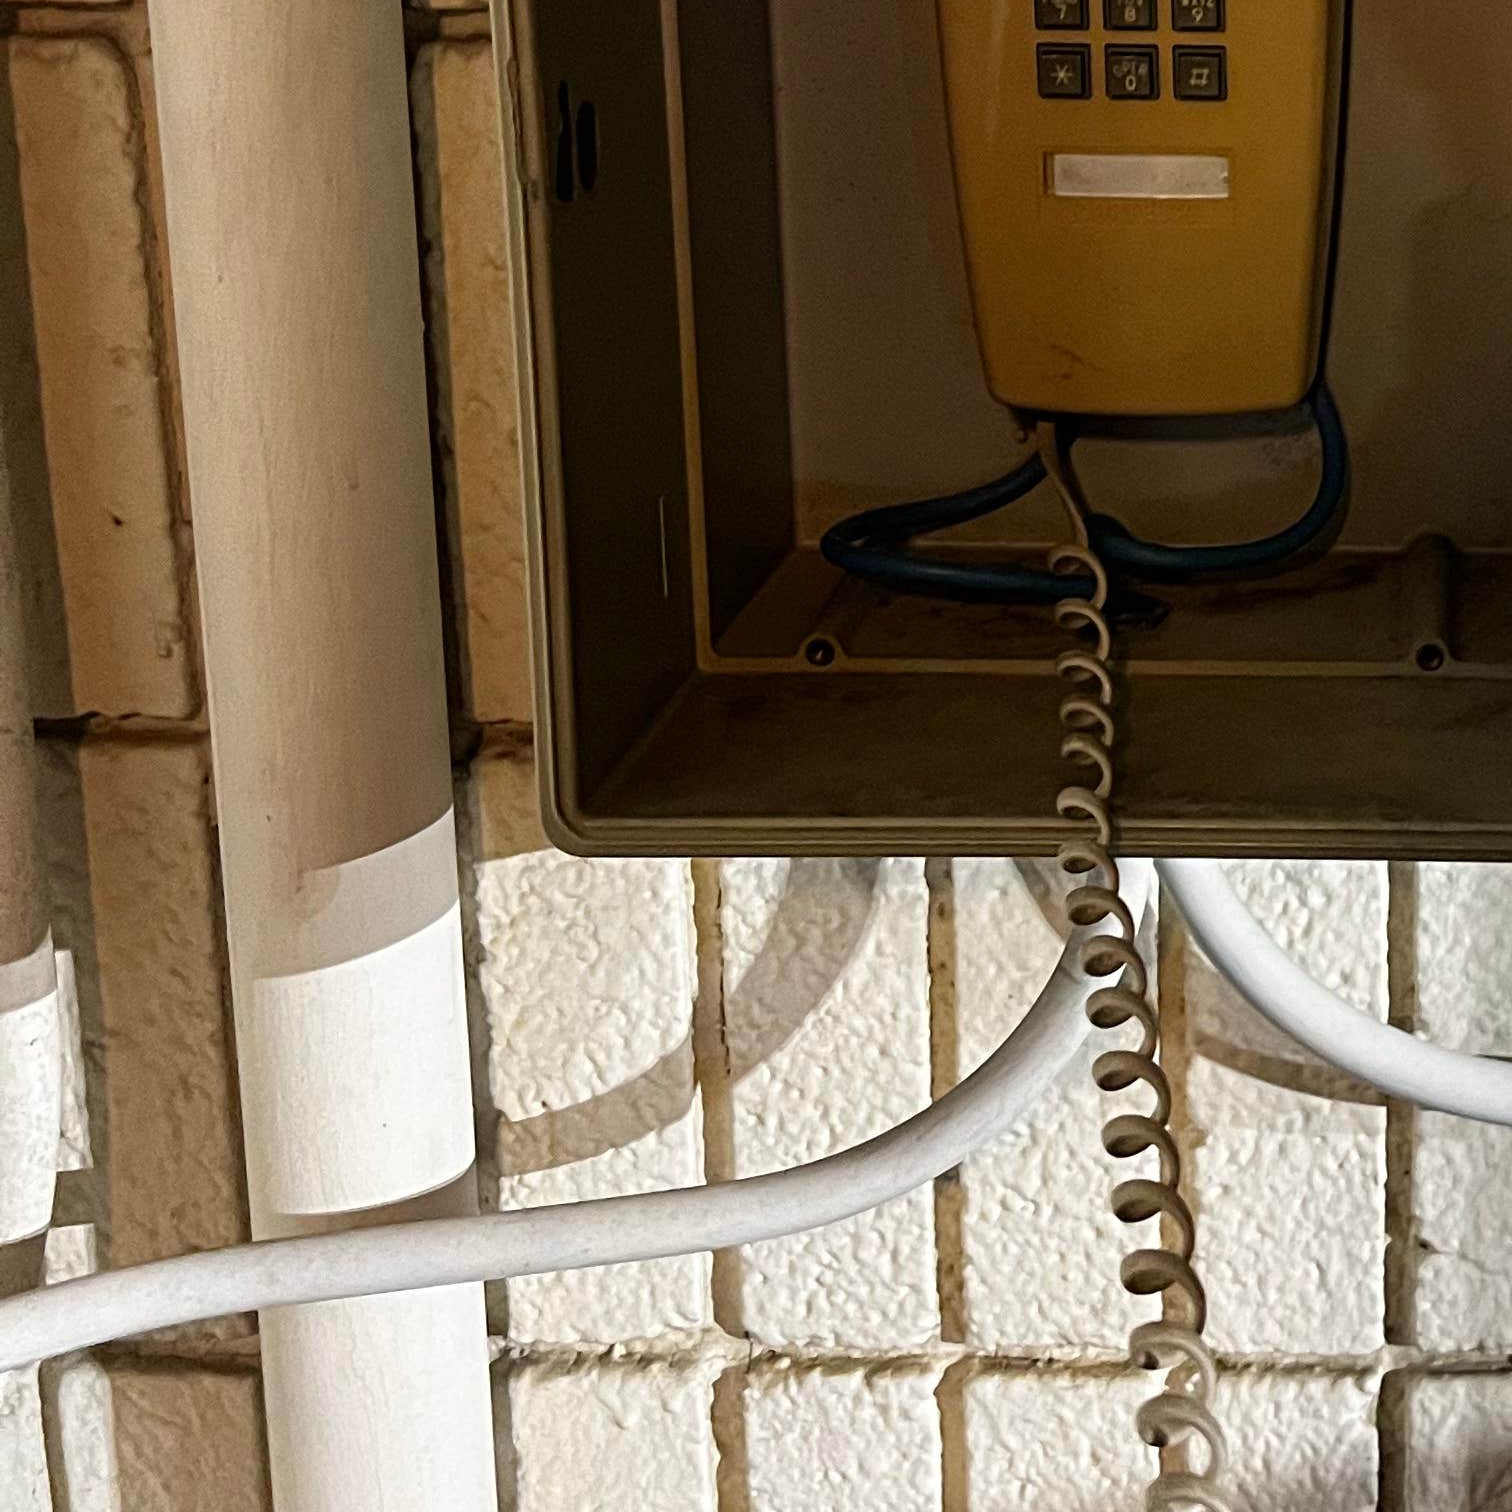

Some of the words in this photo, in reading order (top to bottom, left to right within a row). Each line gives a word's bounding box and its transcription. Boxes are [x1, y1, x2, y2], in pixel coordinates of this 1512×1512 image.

[1055, 4, 1067, 20] 7
[1124, 6, 1136, 23] 8
[1191, 7, 1203, 24] 9
